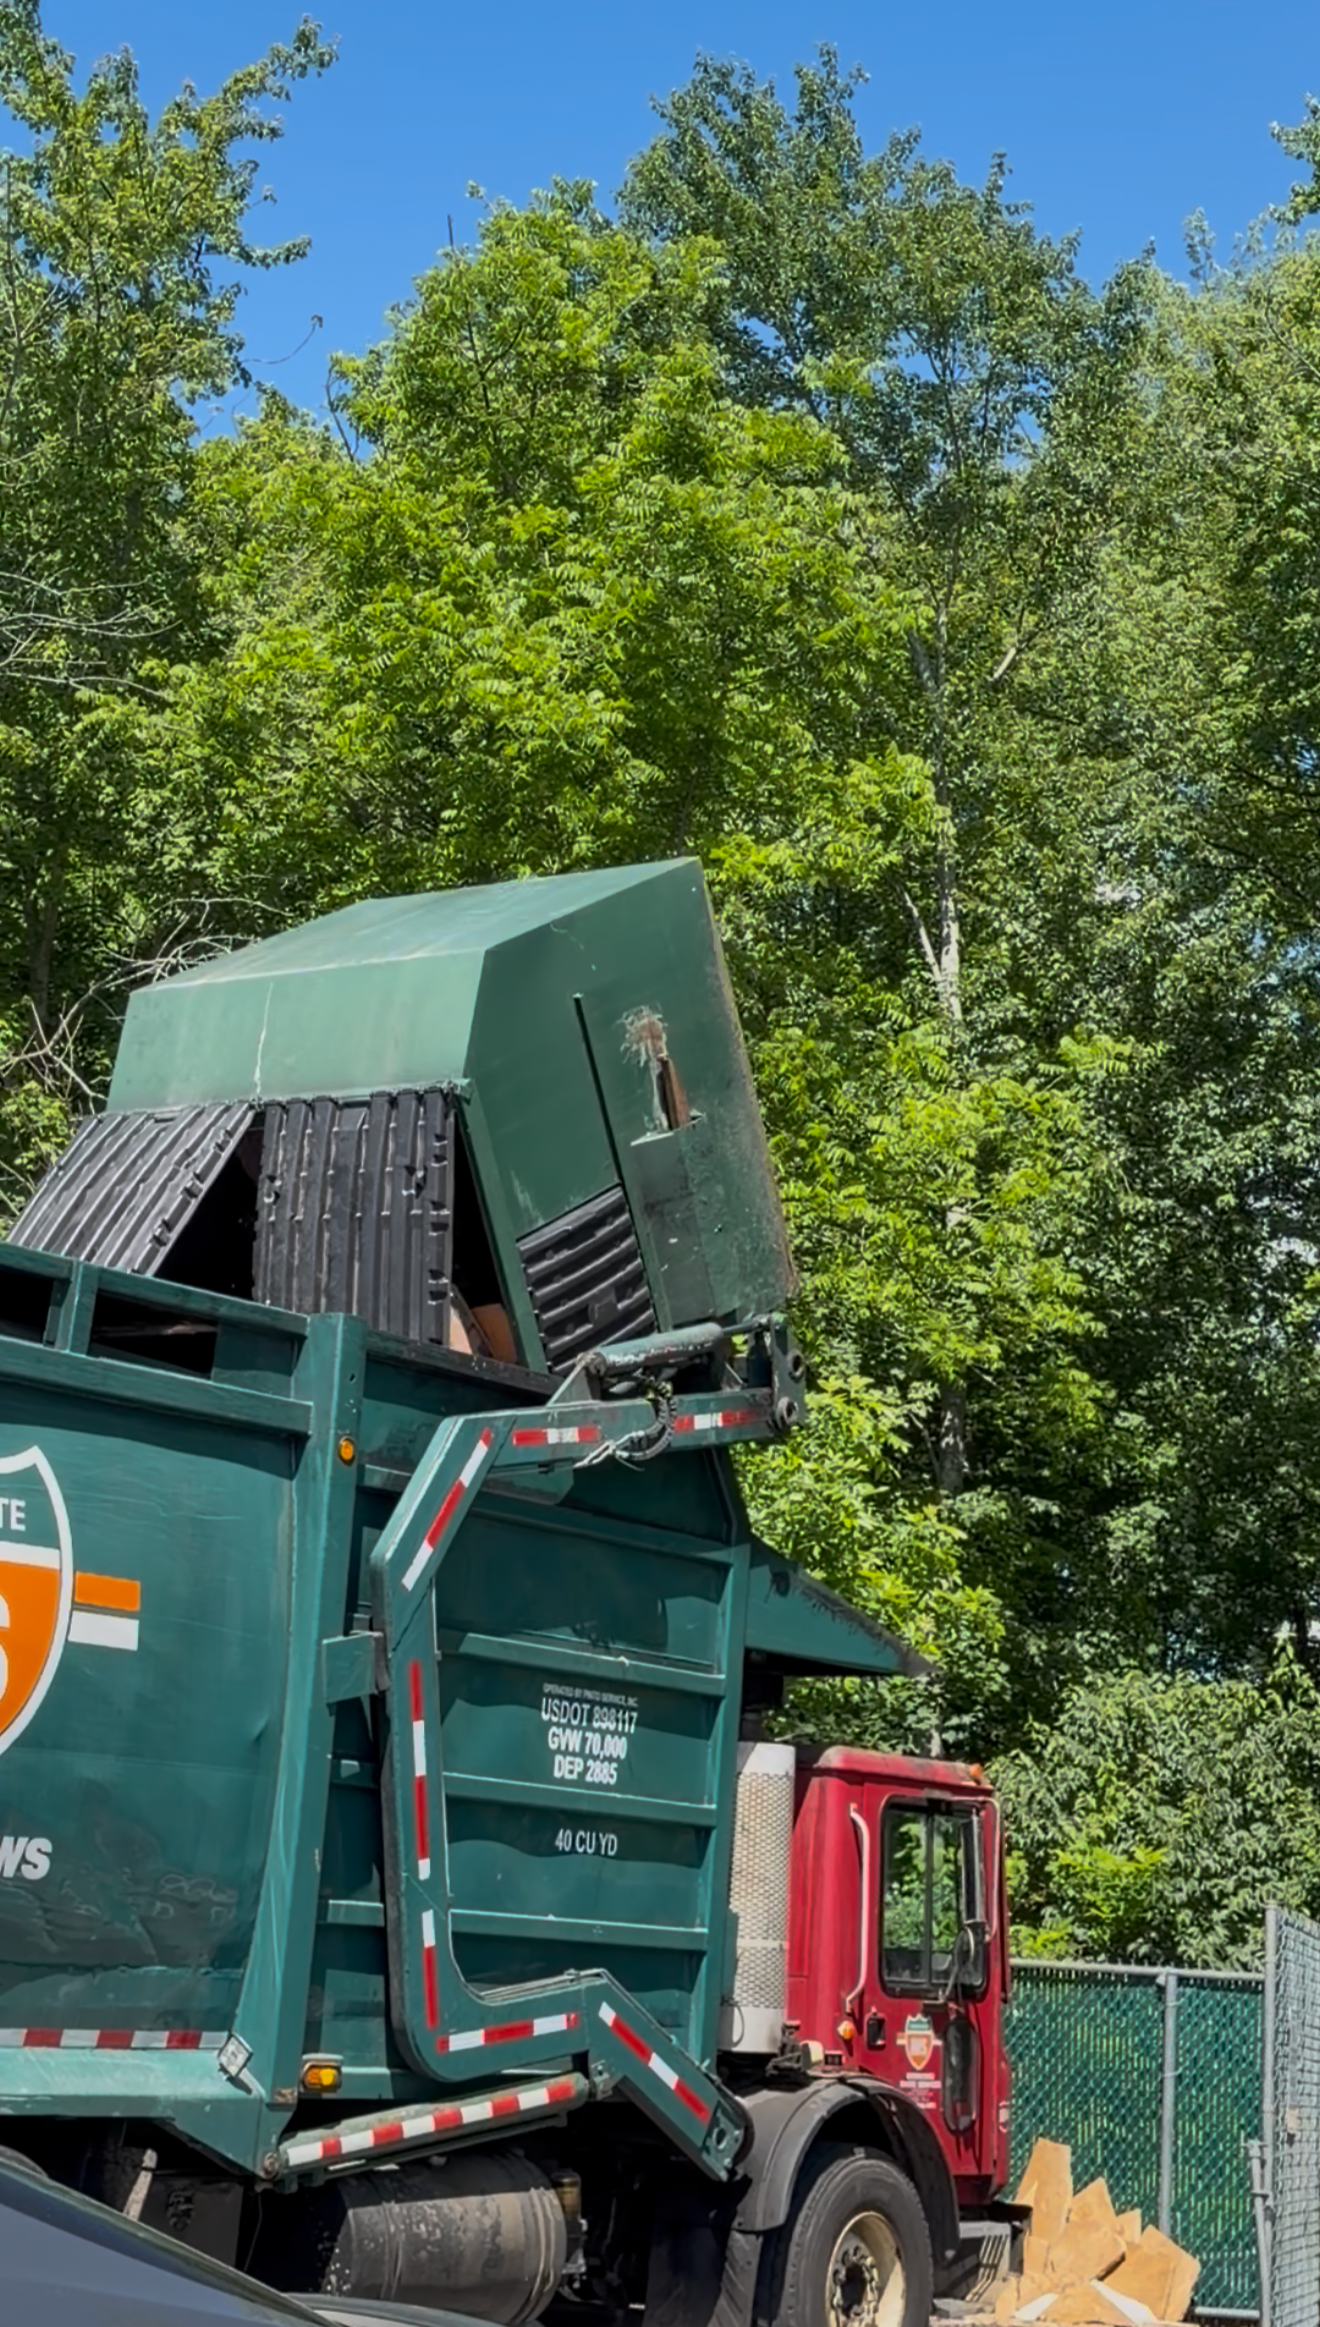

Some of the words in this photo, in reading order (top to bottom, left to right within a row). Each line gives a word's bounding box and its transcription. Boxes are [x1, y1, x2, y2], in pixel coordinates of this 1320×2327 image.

[541, 1697, 590, 1726] USDOT
[593, 1706, 638, 1734] 898117
[548, 1726, 583, 1753] GVW
[585, 1731, 628, 1760] 70,000
[554, 1754, 584, 1780] DEP
[555, 1828, 572, 1852] 40
[576, 1830, 595, 1854] CU
[599, 1833, 618, 1856] YD
